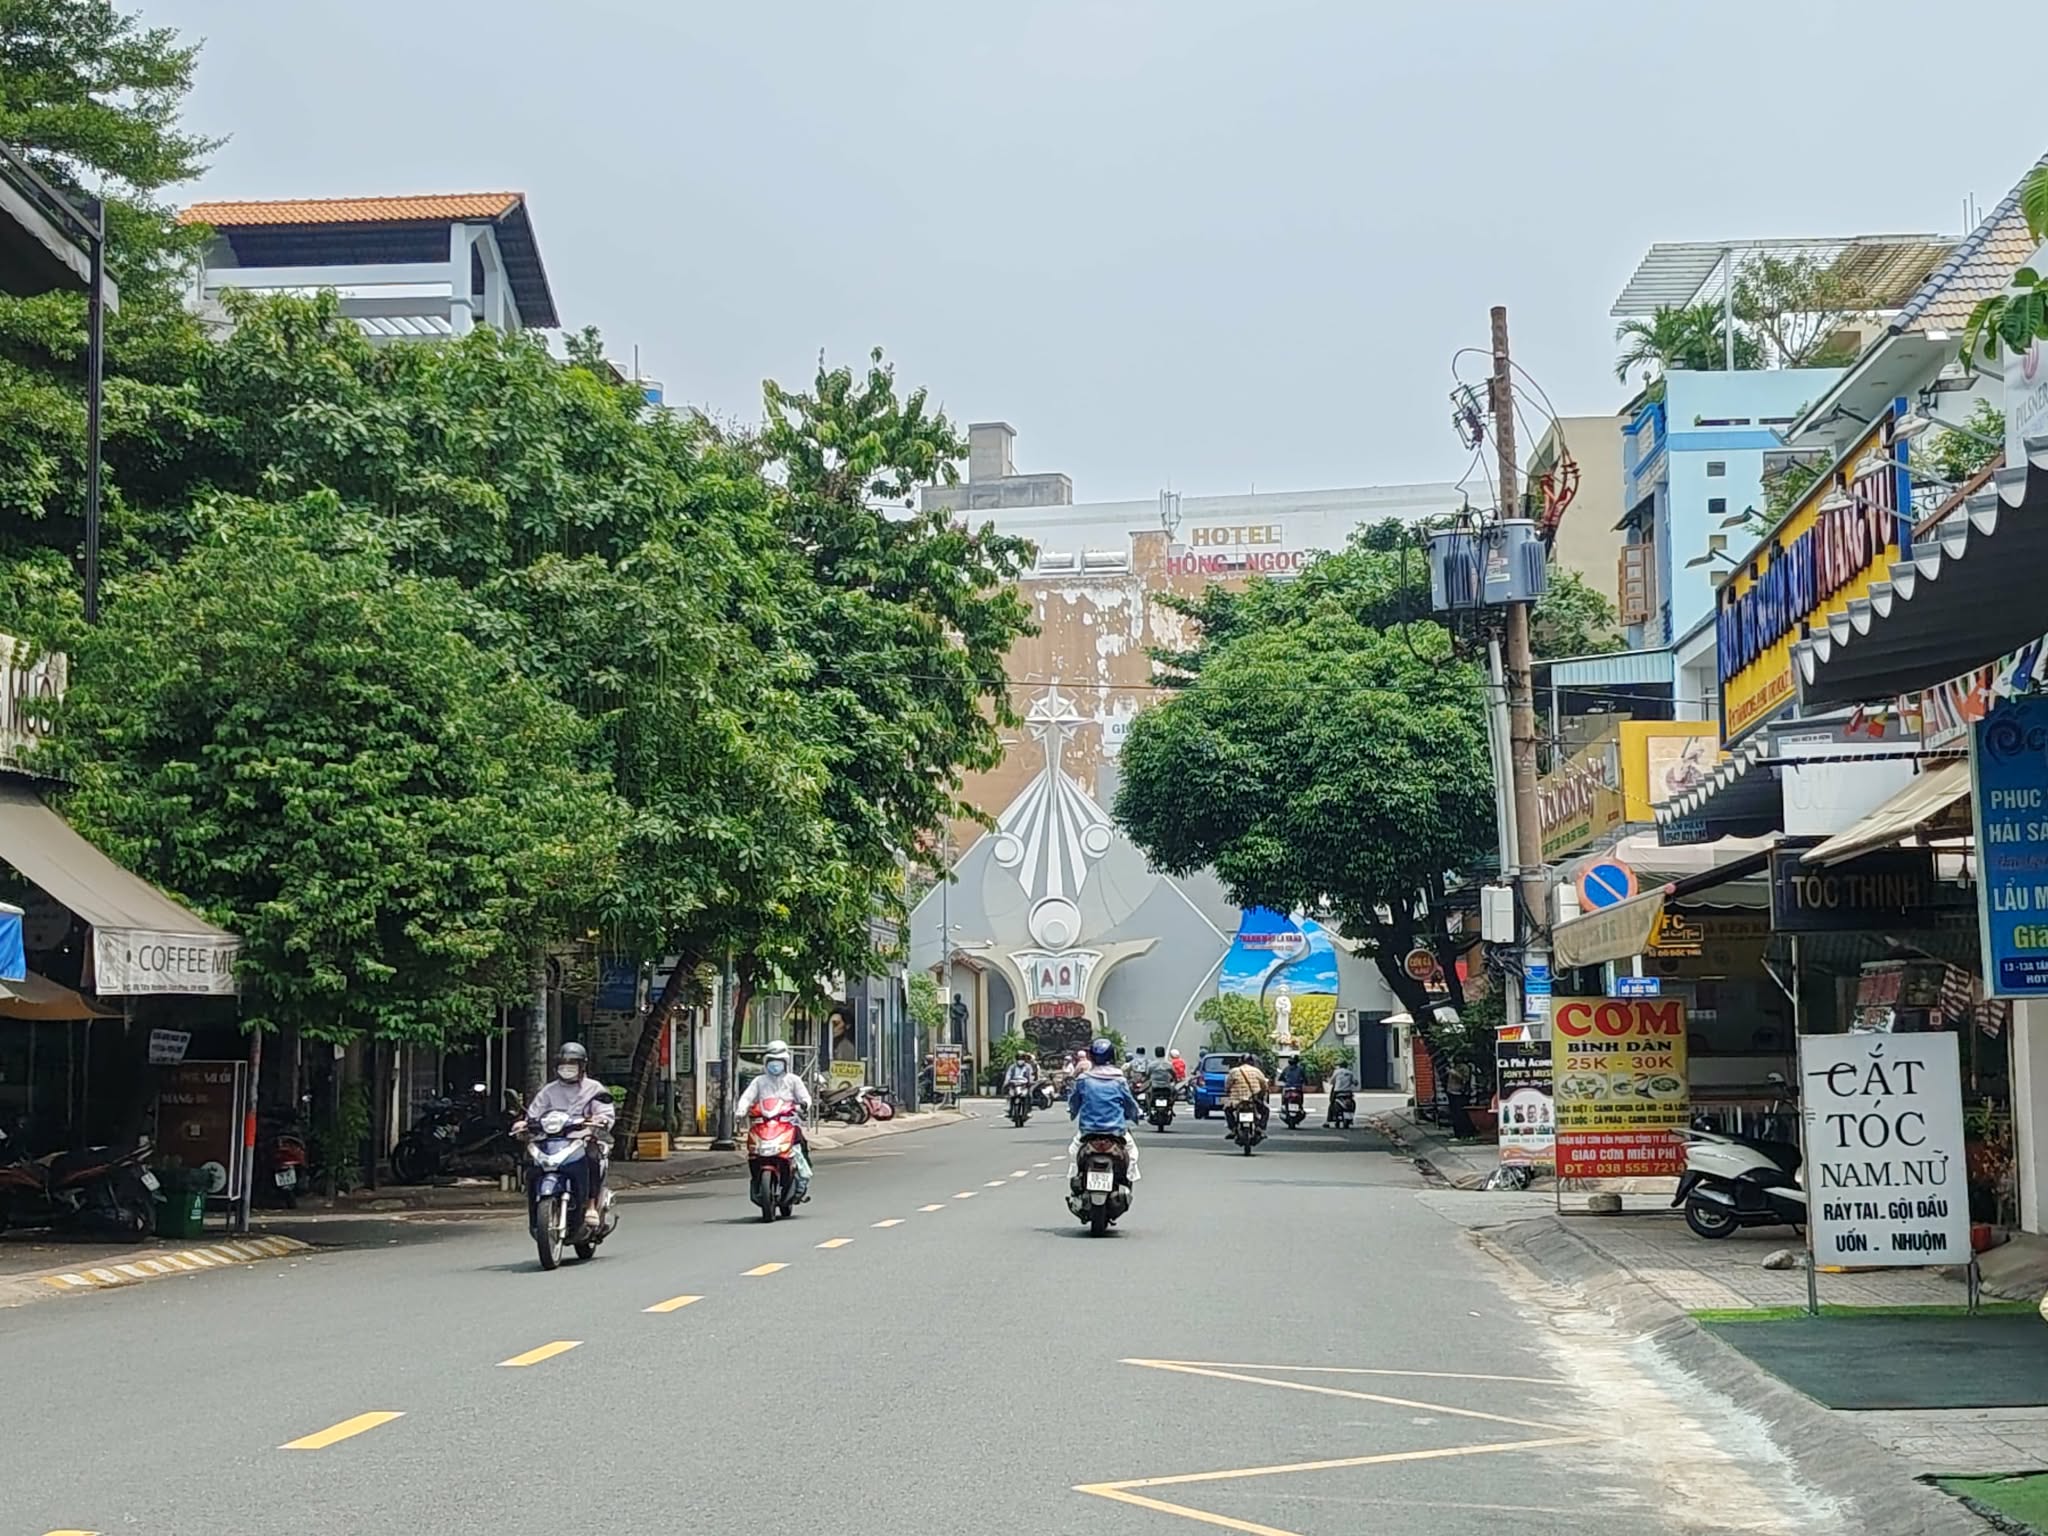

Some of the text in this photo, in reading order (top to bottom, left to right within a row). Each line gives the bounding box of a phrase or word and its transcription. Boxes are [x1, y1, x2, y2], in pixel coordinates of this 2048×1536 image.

[1192, 525, 1281, 546] HOTEL
[1990, 788, 2041, 813] PHỤC
[1989, 816, 2021, 843] HẢI
[1791, 868, 1840, 909] TÓC
[1993, 877, 2028, 911] LẨU
[138, 945, 208, 974] COFFEE
[1555, 1000, 1682, 1037] CƠM
[1567, 1038, 1672, 1053] BÌNH DÂN
[1566, 1057, 1608, 1071] 25K
[1631, 1055, 1673, 1070] 30K
[1827, 1042, 1926, 1098] CẮT
[1825, 1099, 1927, 1148] TÓC
[1564, 1164, 1584, 1174] ĐT
[1596, 1163, 1621, 1174] 038
[1625, 1163, 1649, 1173] 555
[1571, 1149, 1597, 1161] GIAO
[1599, 1148, 1625, 1161] CƠM
[1888, 1197, 1914, 1224] GỘI
[1916, 1193, 1949, 1218] ĐẦU
[1835, 1227, 1868, 1252] UỐN
[1891, 1229, 1948, 1256] NHUỘM
